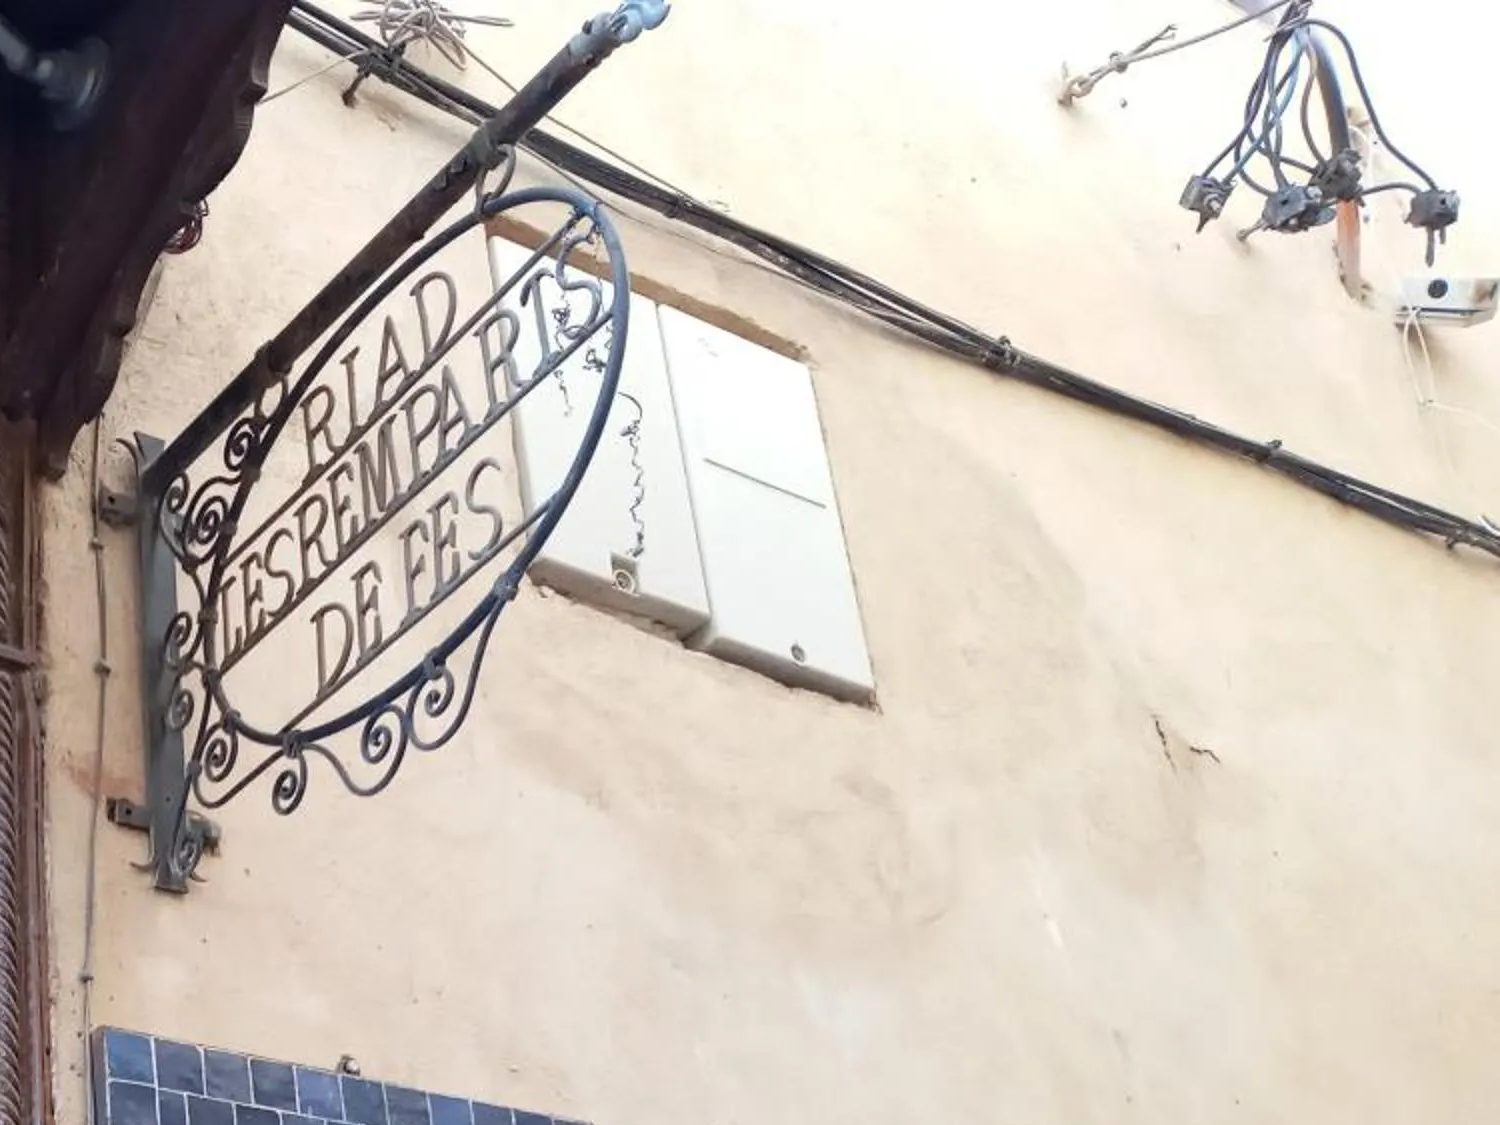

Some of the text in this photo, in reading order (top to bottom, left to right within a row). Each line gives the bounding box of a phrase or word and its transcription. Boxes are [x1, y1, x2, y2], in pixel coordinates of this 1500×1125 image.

[217, 232, 602, 664] LES REMPARTS
[299, 270, 457, 484] RIAD
[310, 456, 502, 697] DE FES
